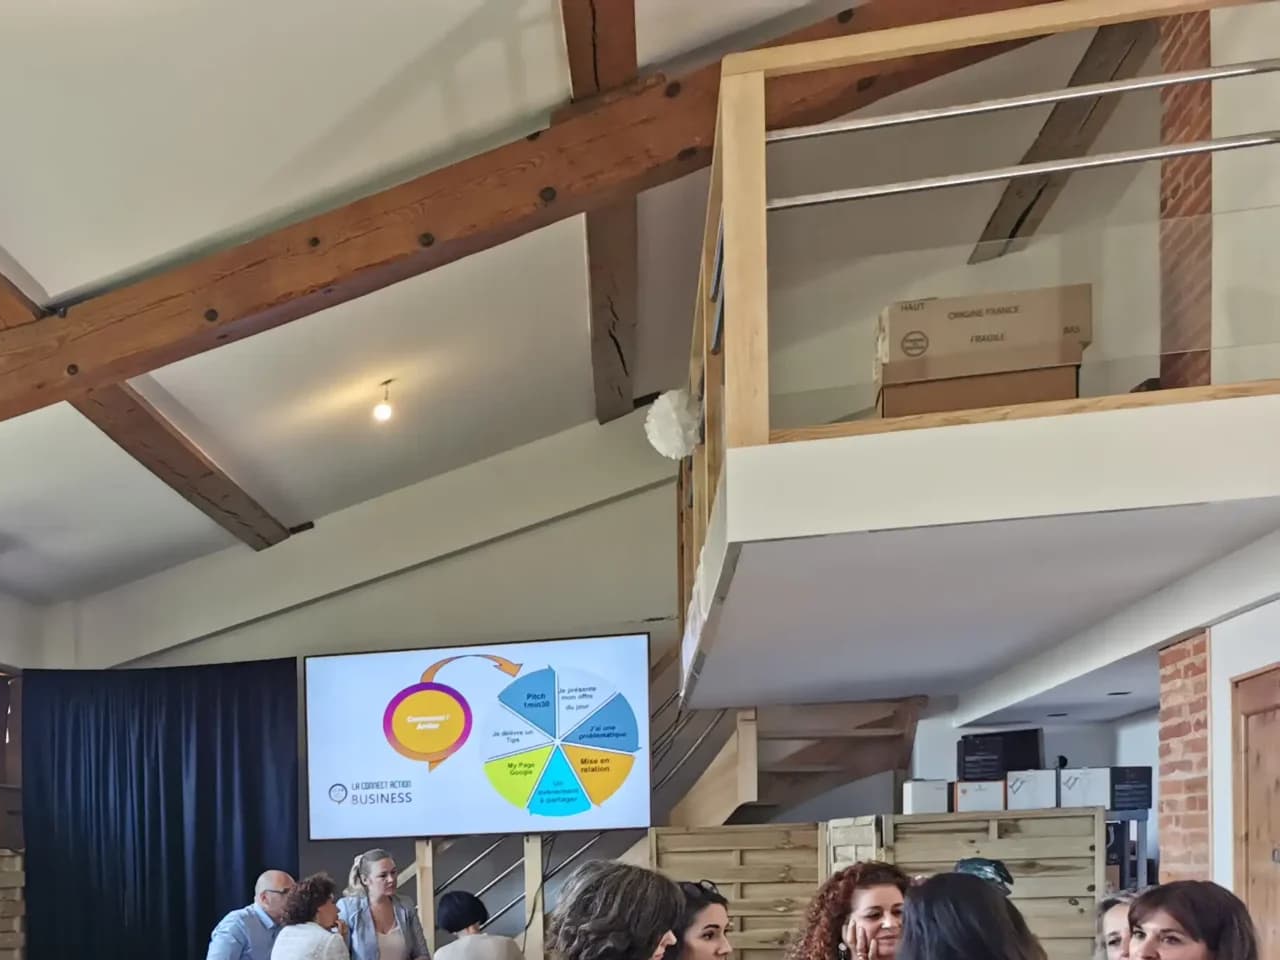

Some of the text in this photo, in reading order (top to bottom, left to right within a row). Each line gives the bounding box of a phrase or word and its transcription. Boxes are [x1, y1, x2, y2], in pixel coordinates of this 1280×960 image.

[901, 303, 925, 312] HAUT
[985, 305, 1019, 315] FRANCE
[970, 333, 1005, 343] FRAGILE
[351, 792, 413, 806] BUSINESS
